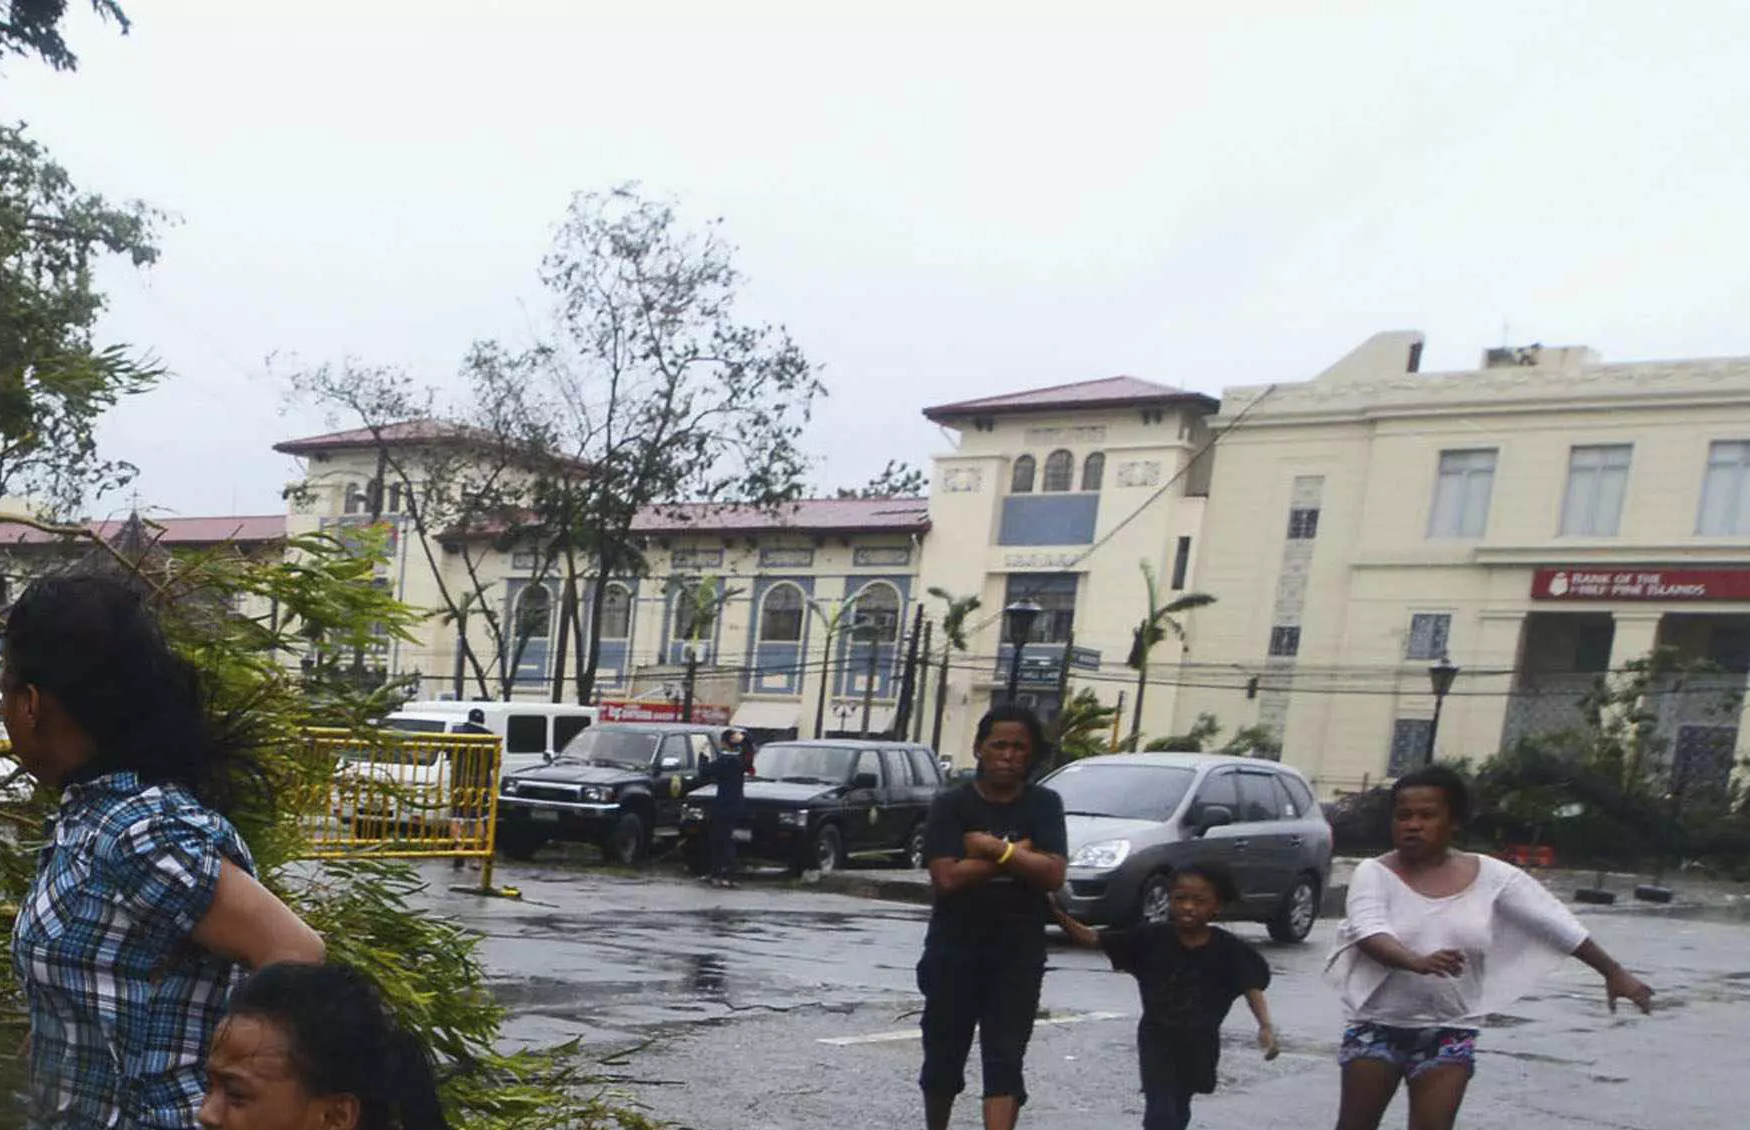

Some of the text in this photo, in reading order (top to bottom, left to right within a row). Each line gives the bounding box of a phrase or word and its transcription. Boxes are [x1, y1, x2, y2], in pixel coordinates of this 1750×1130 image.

[1572, 573, 1661, 584] BANK OF THE
[1647, 584, 1705, 596] ISLANDS
